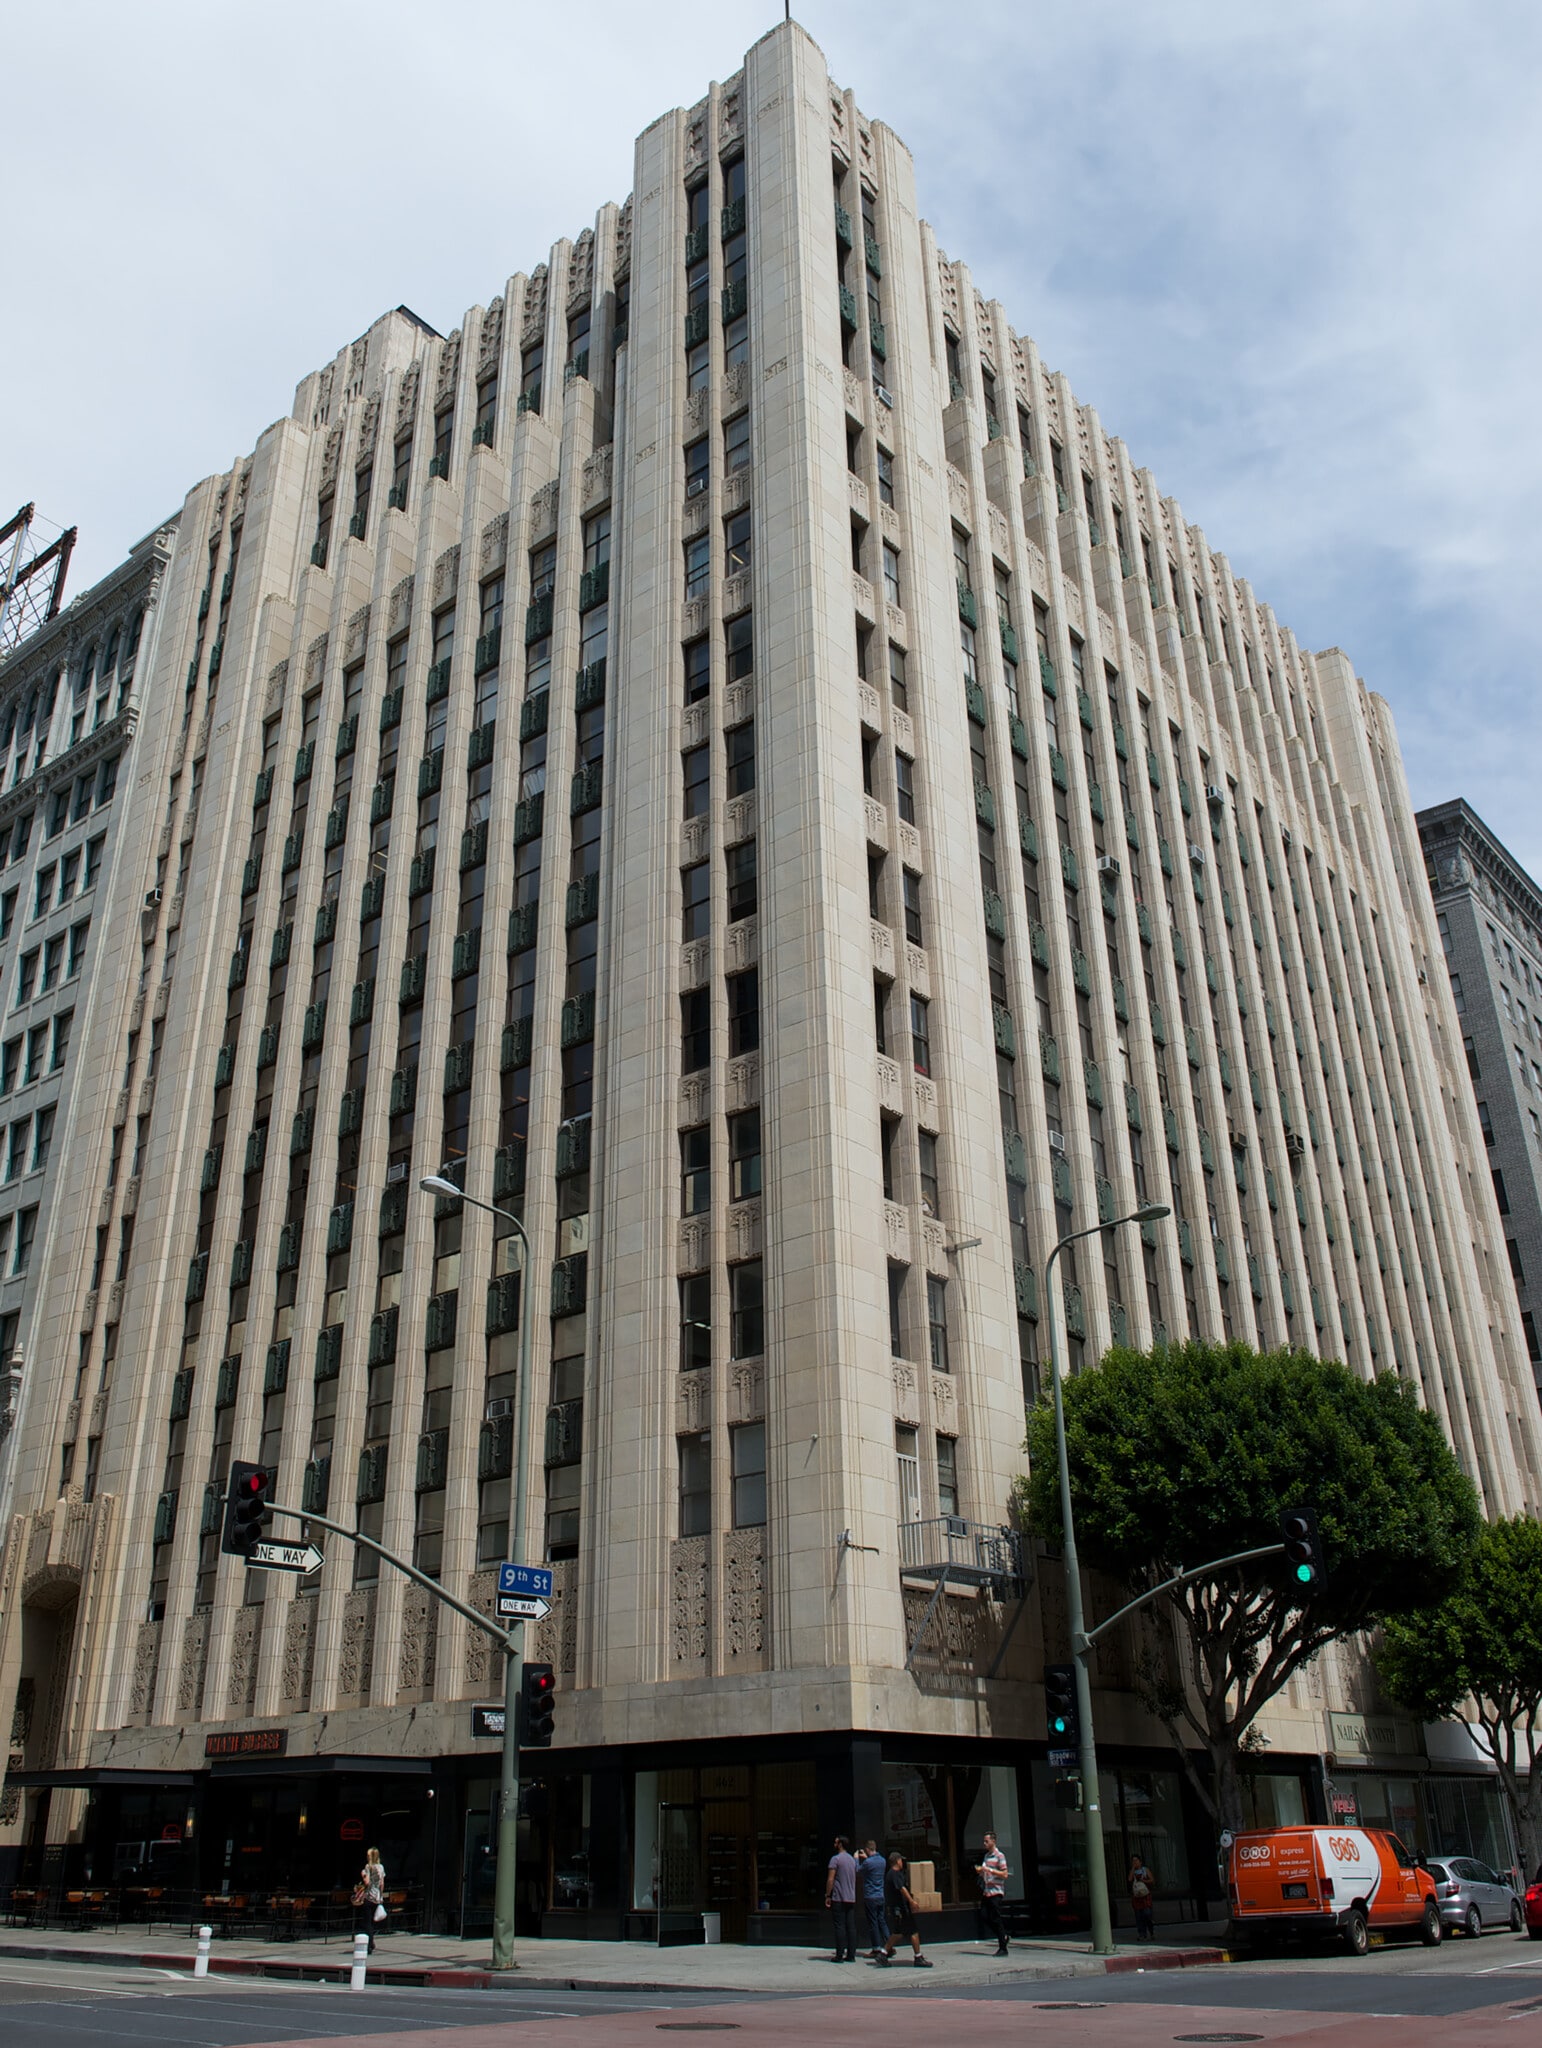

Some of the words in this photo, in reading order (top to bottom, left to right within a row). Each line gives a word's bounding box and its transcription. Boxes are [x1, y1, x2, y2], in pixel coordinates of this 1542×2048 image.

[283, 1549, 306, 1564] WAY
[505, 1569, 528, 1586] 9th
[533, 1574, 548, 1590] St
[503, 1600, 518, 1610] ONE
[520, 1602, 536, 1611] WAY
[1337, 1724, 1360, 1740] NAILS
[1240, 1846, 1270, 1860] TNT
[1280, 1848, 1304, 1856] express
[1329, 1836, 1360, 1862] TNT
